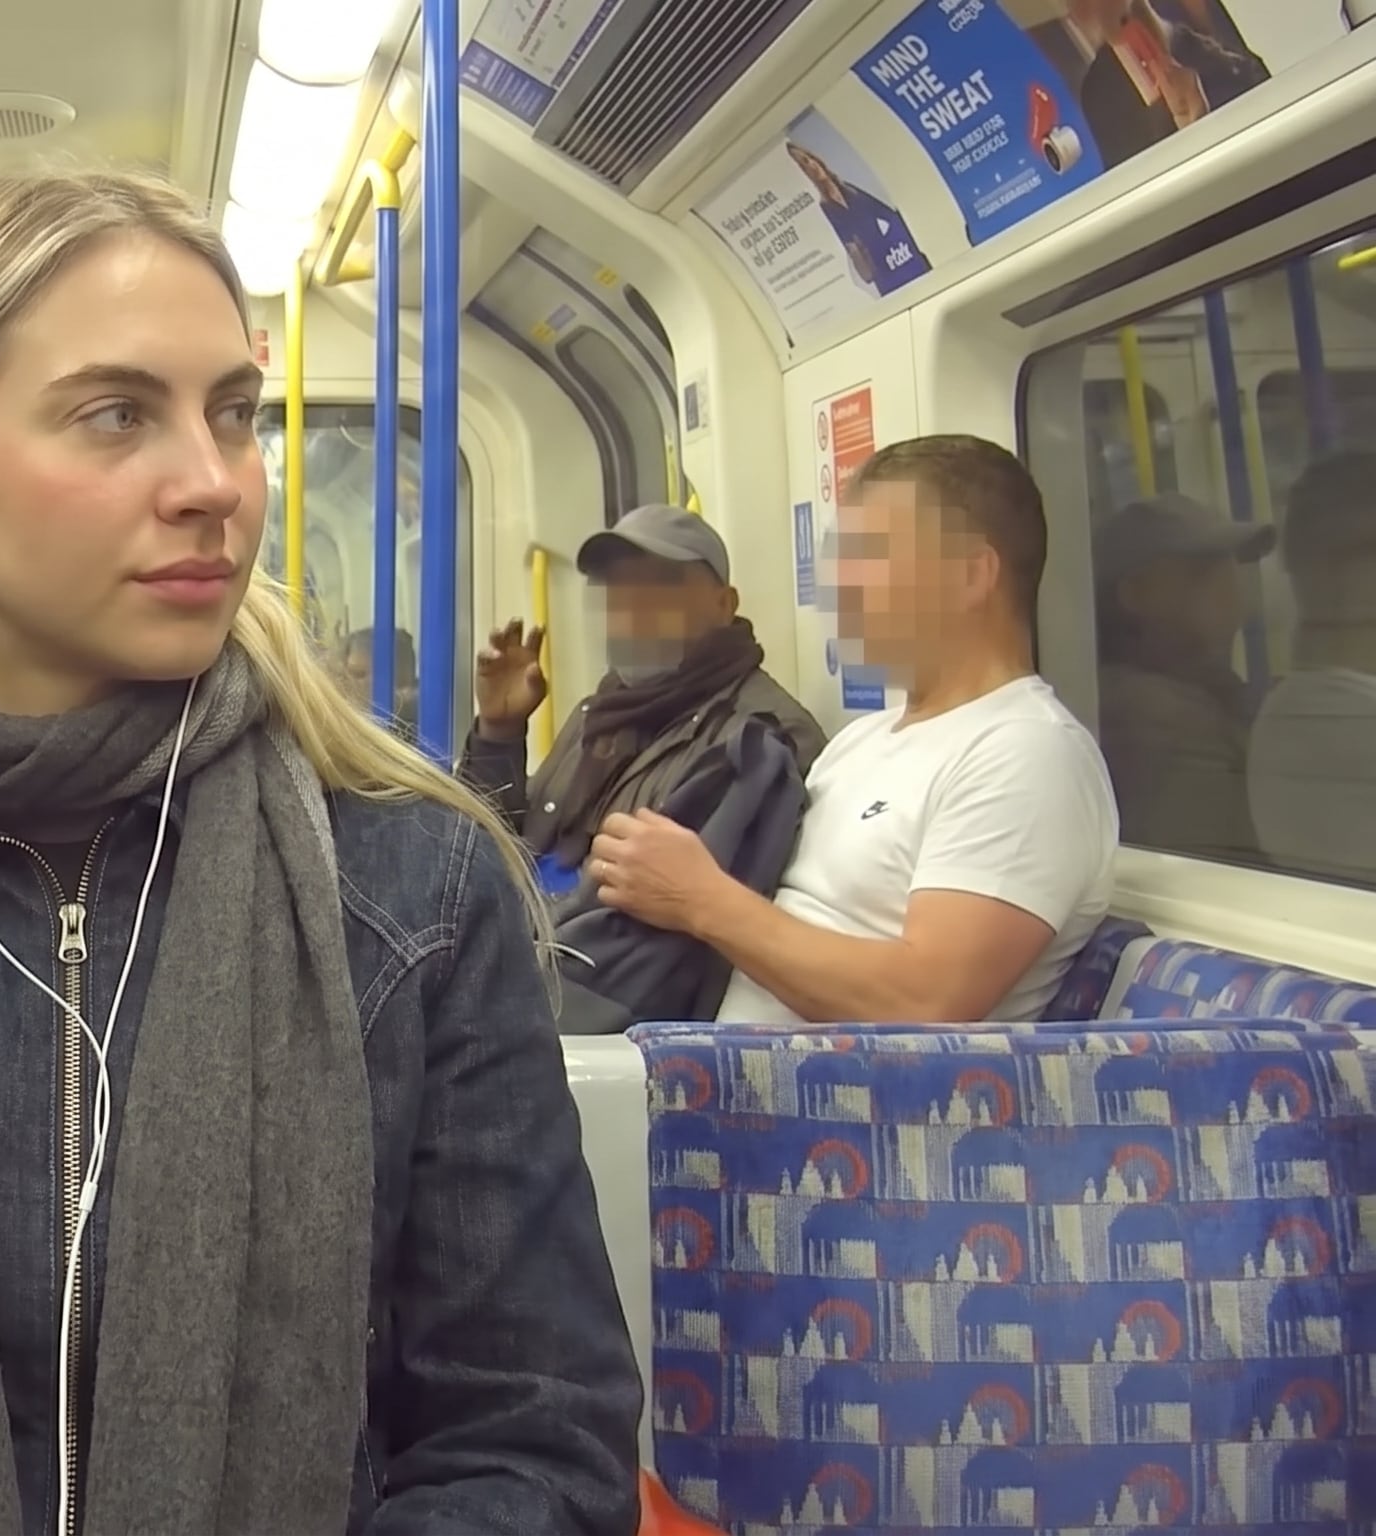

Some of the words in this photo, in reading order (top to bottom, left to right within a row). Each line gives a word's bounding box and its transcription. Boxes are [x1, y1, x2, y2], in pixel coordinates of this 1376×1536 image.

[870, 34, 929, 88] MIND
[895, 65, 946, 110] THE
[919, 69, 994, 141] SWEAT
